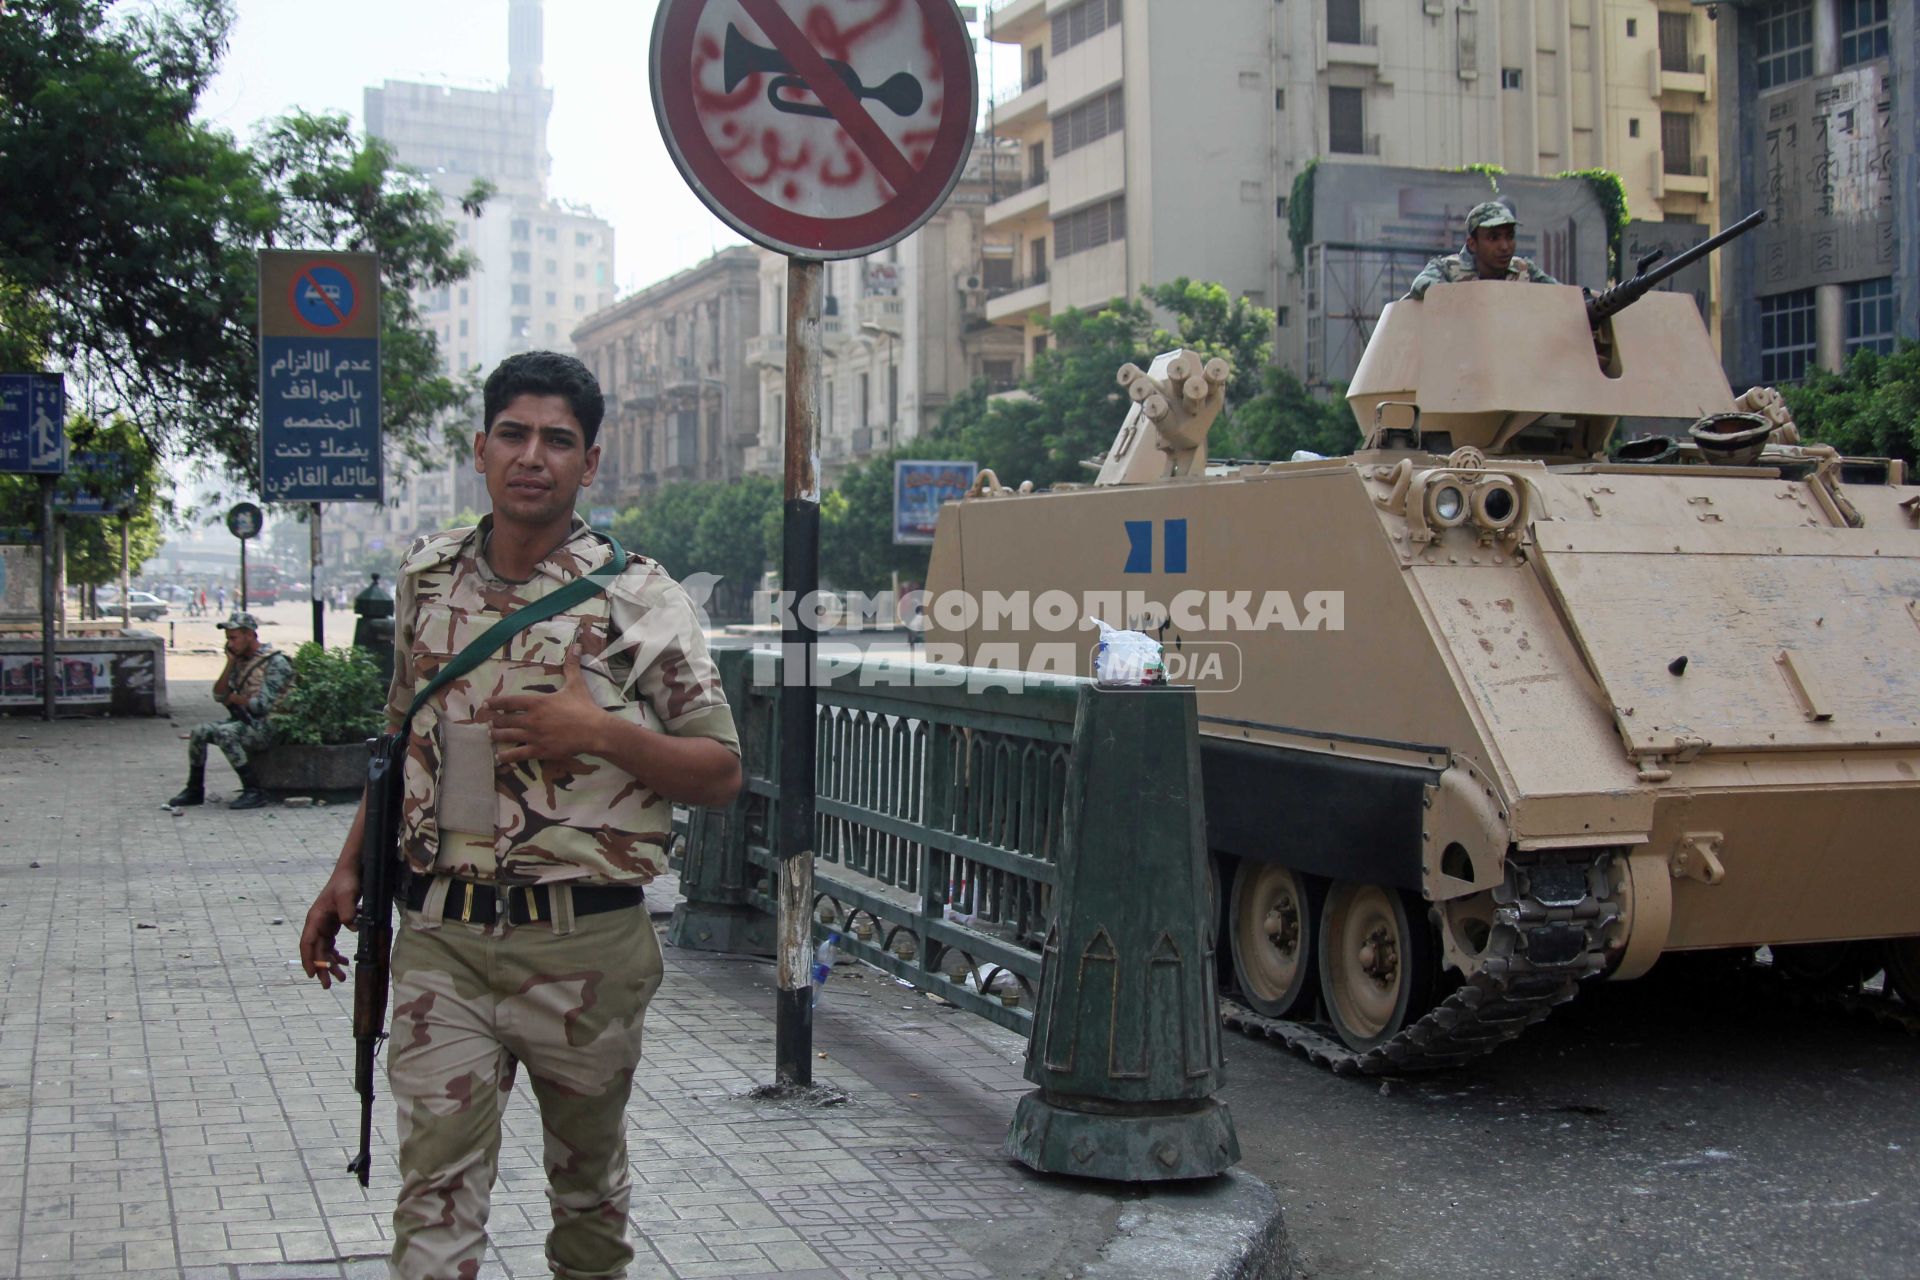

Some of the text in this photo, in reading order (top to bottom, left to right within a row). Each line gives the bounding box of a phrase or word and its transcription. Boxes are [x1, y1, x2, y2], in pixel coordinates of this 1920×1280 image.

[270, 348, 372, 378] عدم الالتزام
[280, 378, 363, 405] بالمواقف
[274, 437, 370, 462] يضعك تحت
[266, 464, 328, 492] القانون
